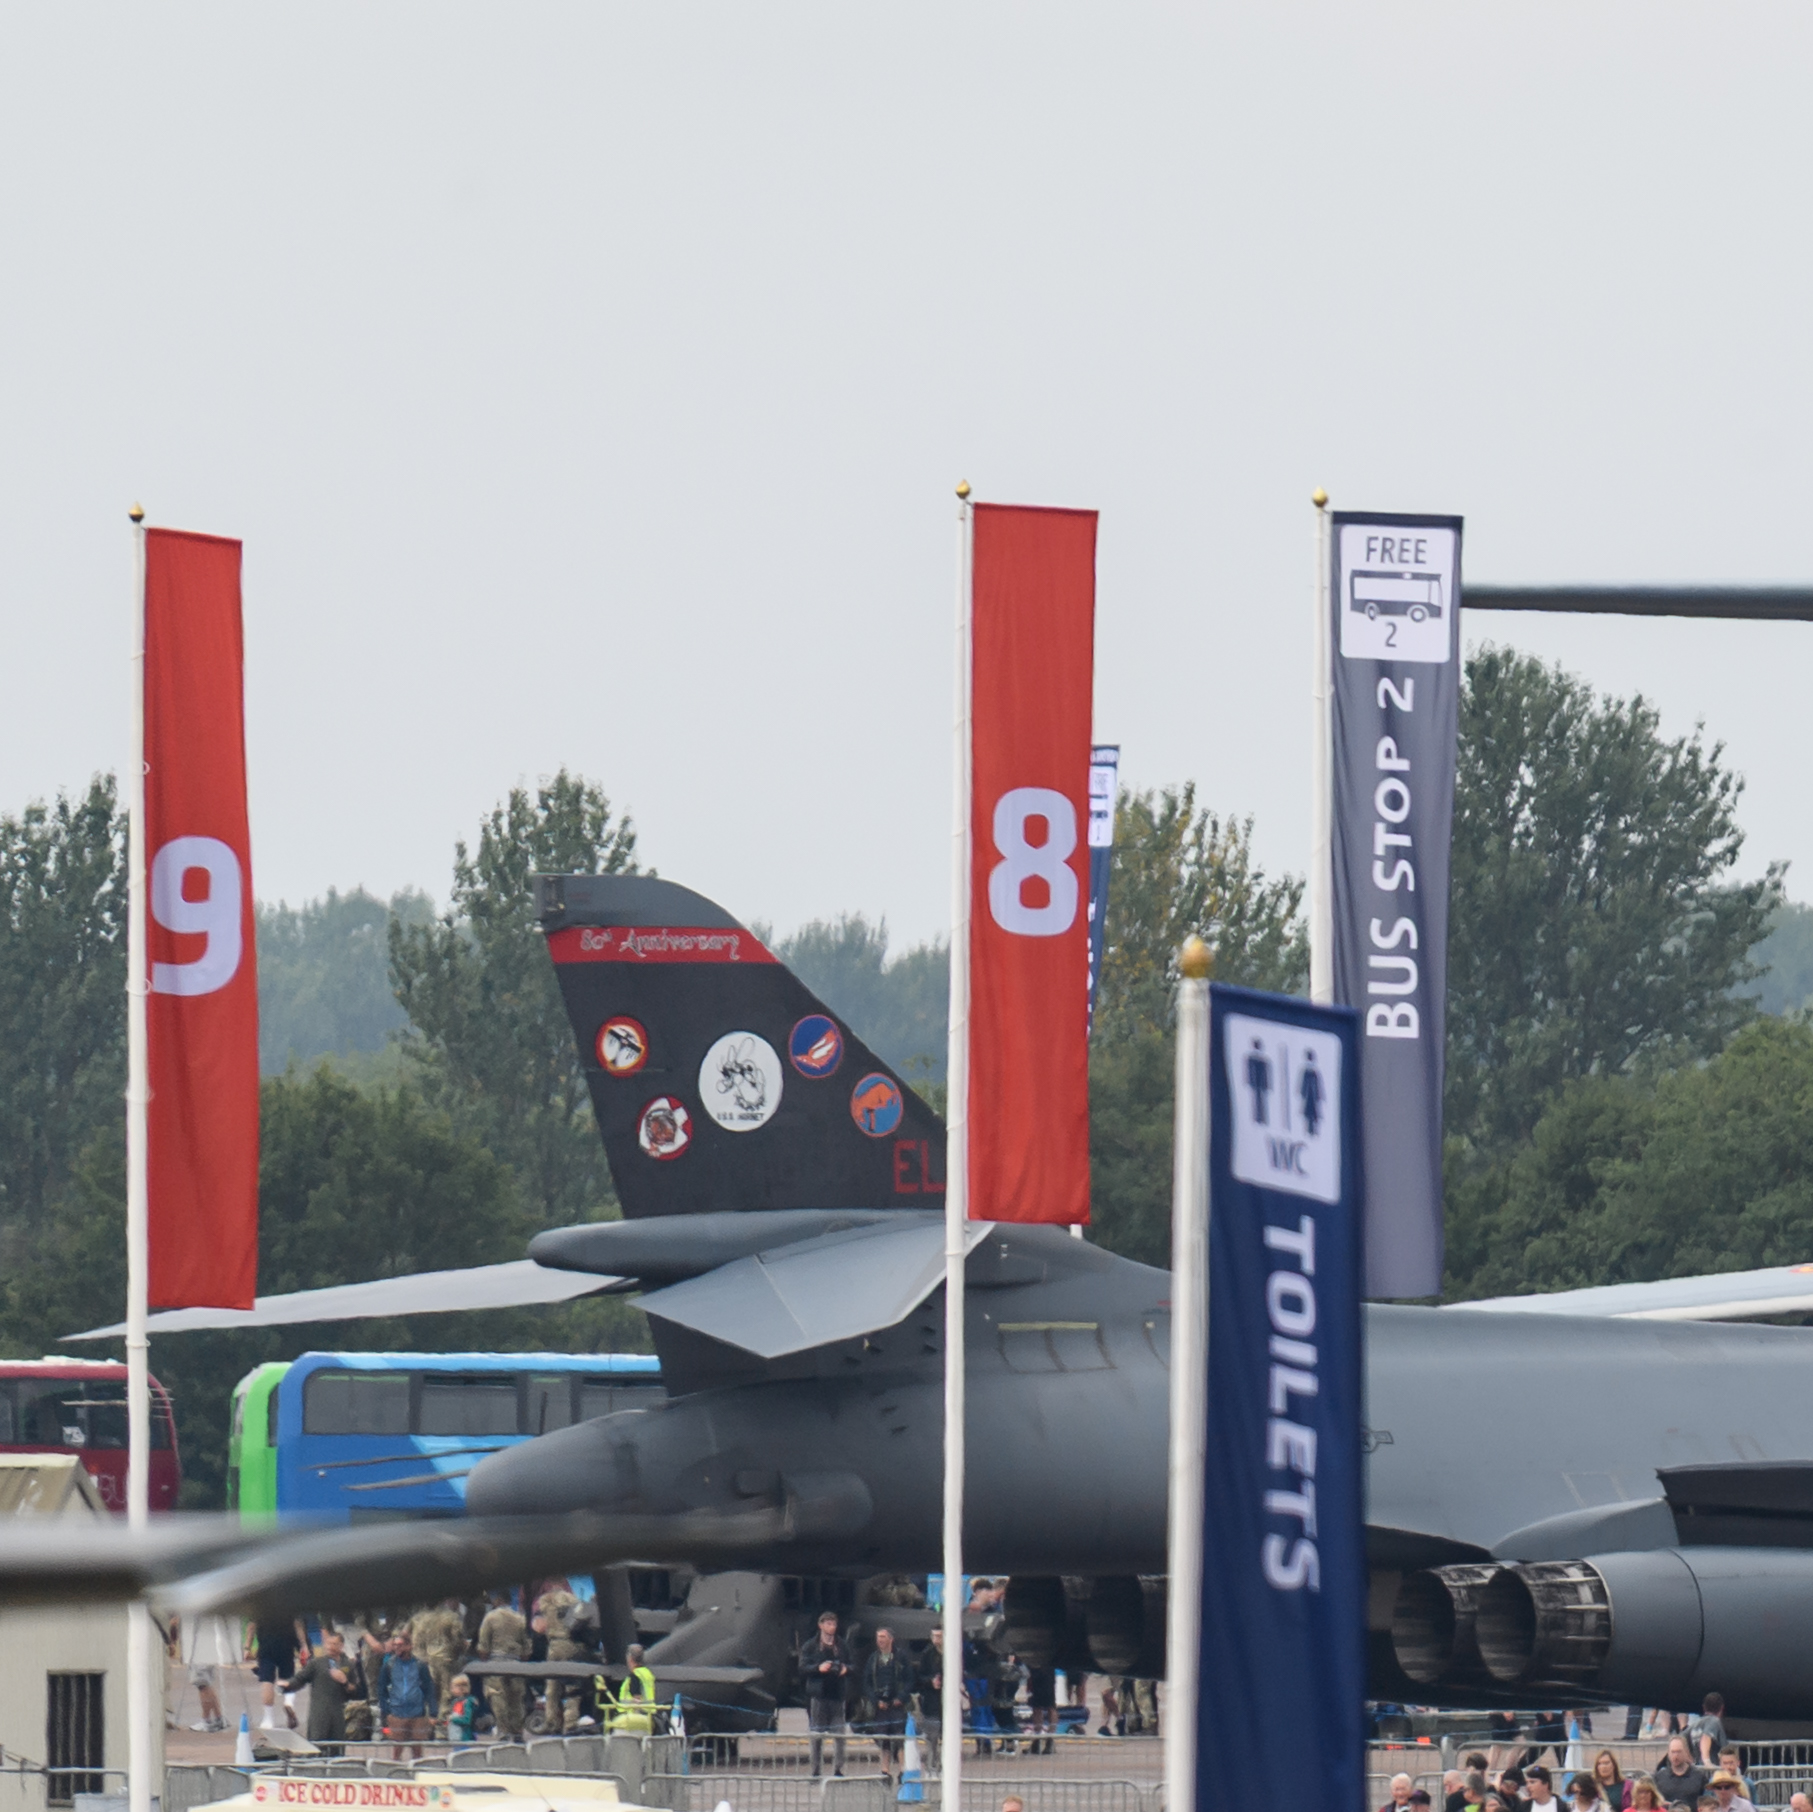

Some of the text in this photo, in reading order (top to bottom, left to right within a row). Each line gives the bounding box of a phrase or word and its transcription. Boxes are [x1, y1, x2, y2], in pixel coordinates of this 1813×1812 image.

[1366, 535, 1428, 564] FREE
[1384, 621, 1398, 648] 2
[989, 787, 1077, 936] 8
[1366, 677, 1420, 1039] BUS STOP 2
[152, 836, 242, 996] 9
[1264, 1136, 1310, 1176] WC
[1261, 1213, 1321, 1593] TOILETS
[278, 1781, 428, 1806] ICE COLD DRINKS
